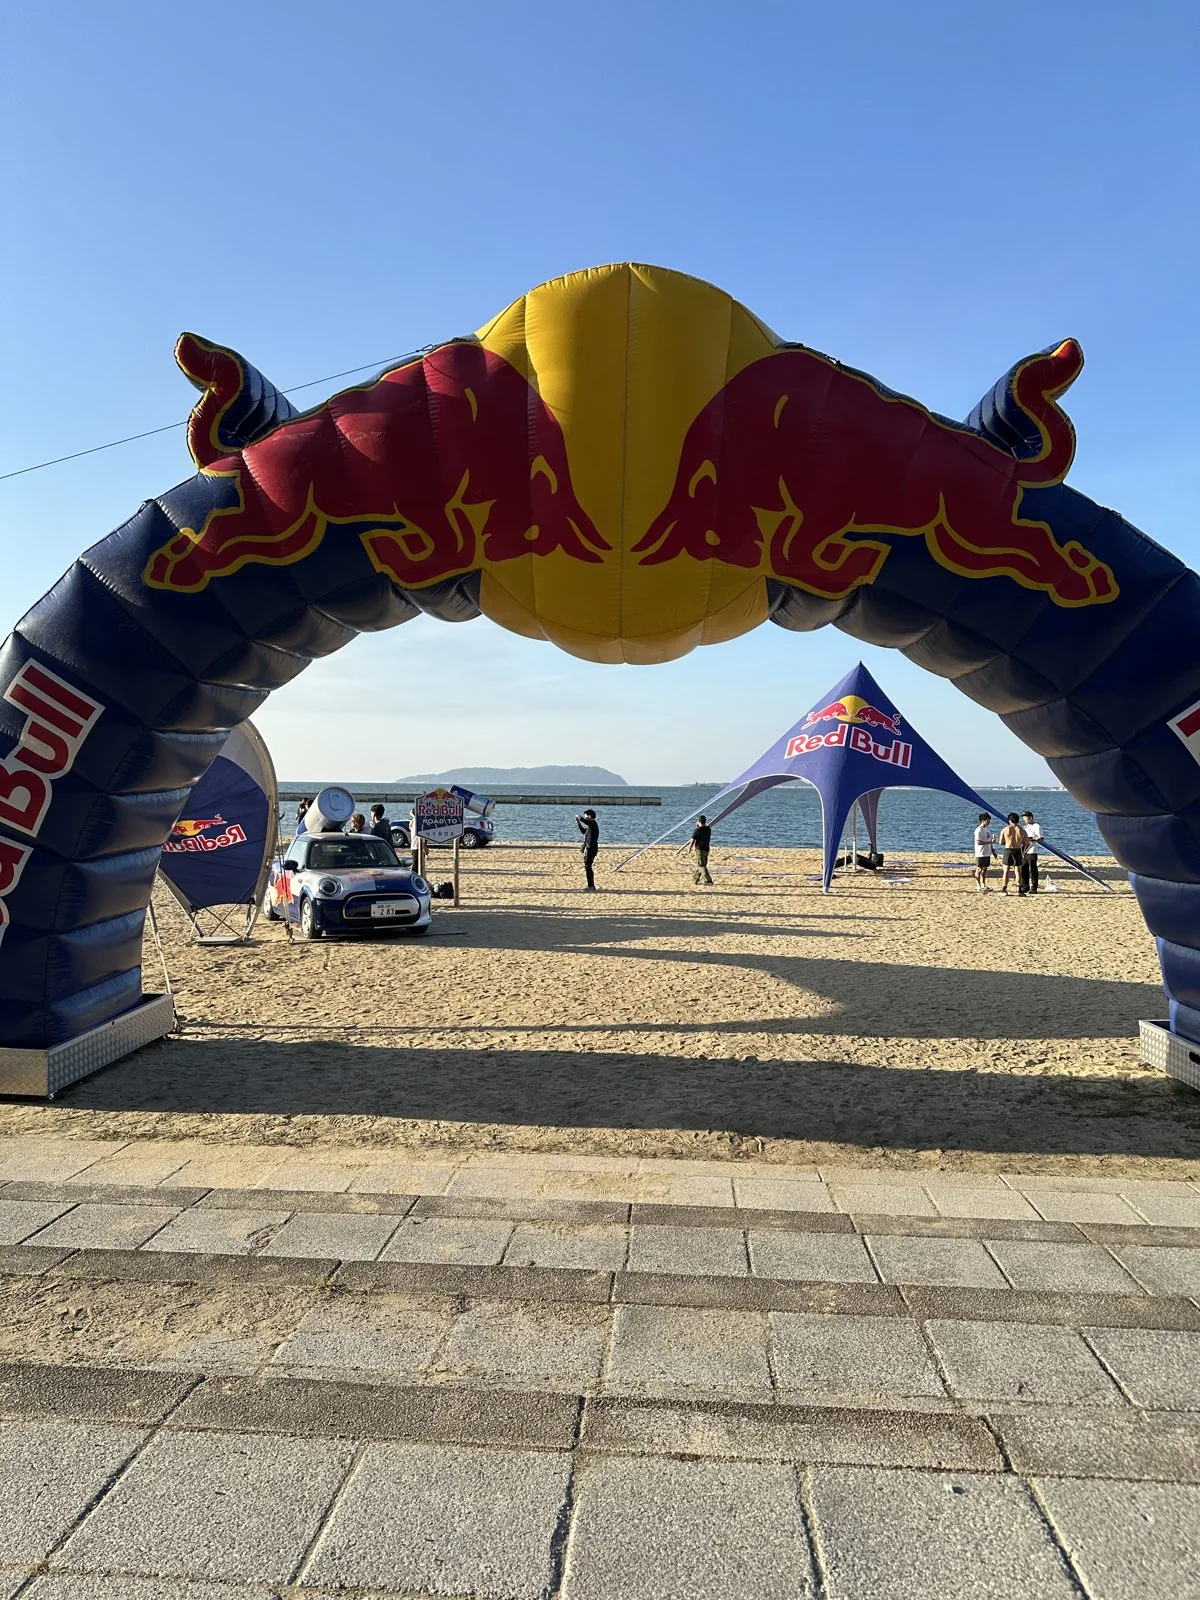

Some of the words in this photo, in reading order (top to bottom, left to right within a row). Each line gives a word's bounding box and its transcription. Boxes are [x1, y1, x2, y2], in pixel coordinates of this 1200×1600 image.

[784, 724, 849, 759] Red
[850, 727, 912, 769] Bull
[418, 804, 440, 816] Red
[441, 804, 462, 816] Bull
